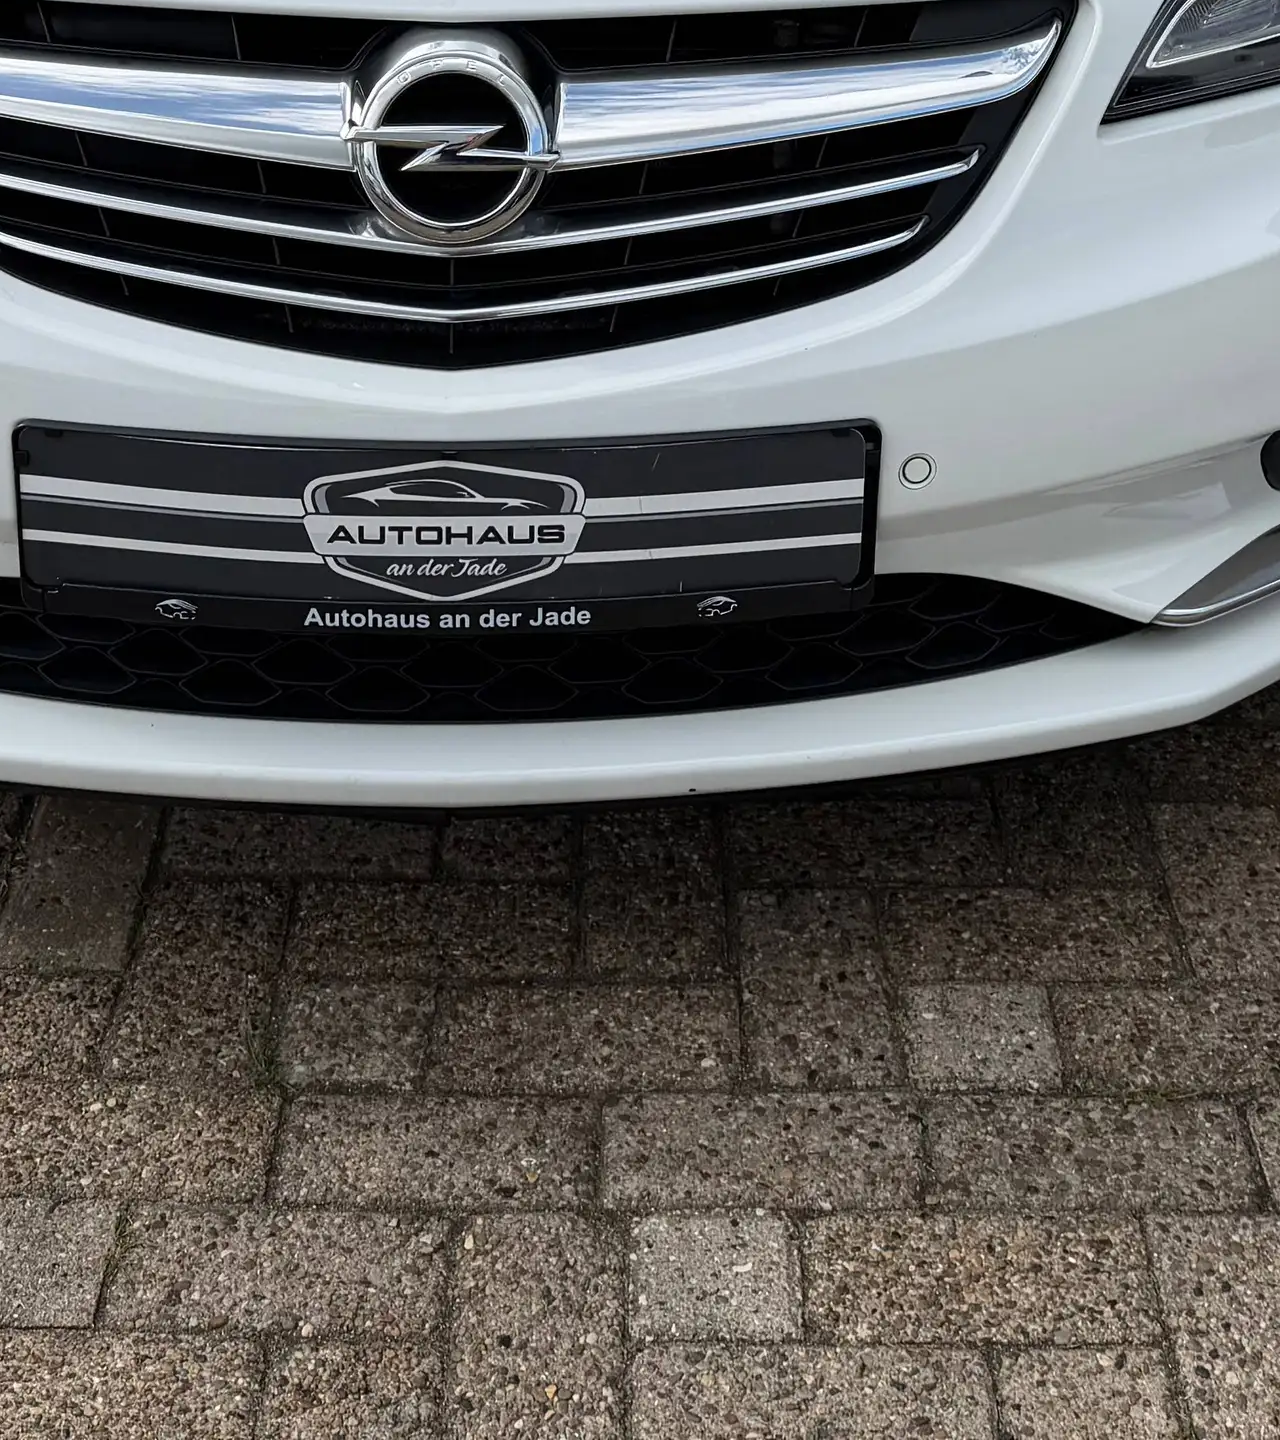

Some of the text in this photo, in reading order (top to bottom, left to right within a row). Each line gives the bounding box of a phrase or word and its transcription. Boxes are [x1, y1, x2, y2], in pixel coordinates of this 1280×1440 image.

[397, 60, 506, 86] OPEL
[326, 524, 566, 545] AUTOHAUS
[386, 558, 508, 578] an der Jade
[303, 606, 592, 629] Autohaus an der Jade
